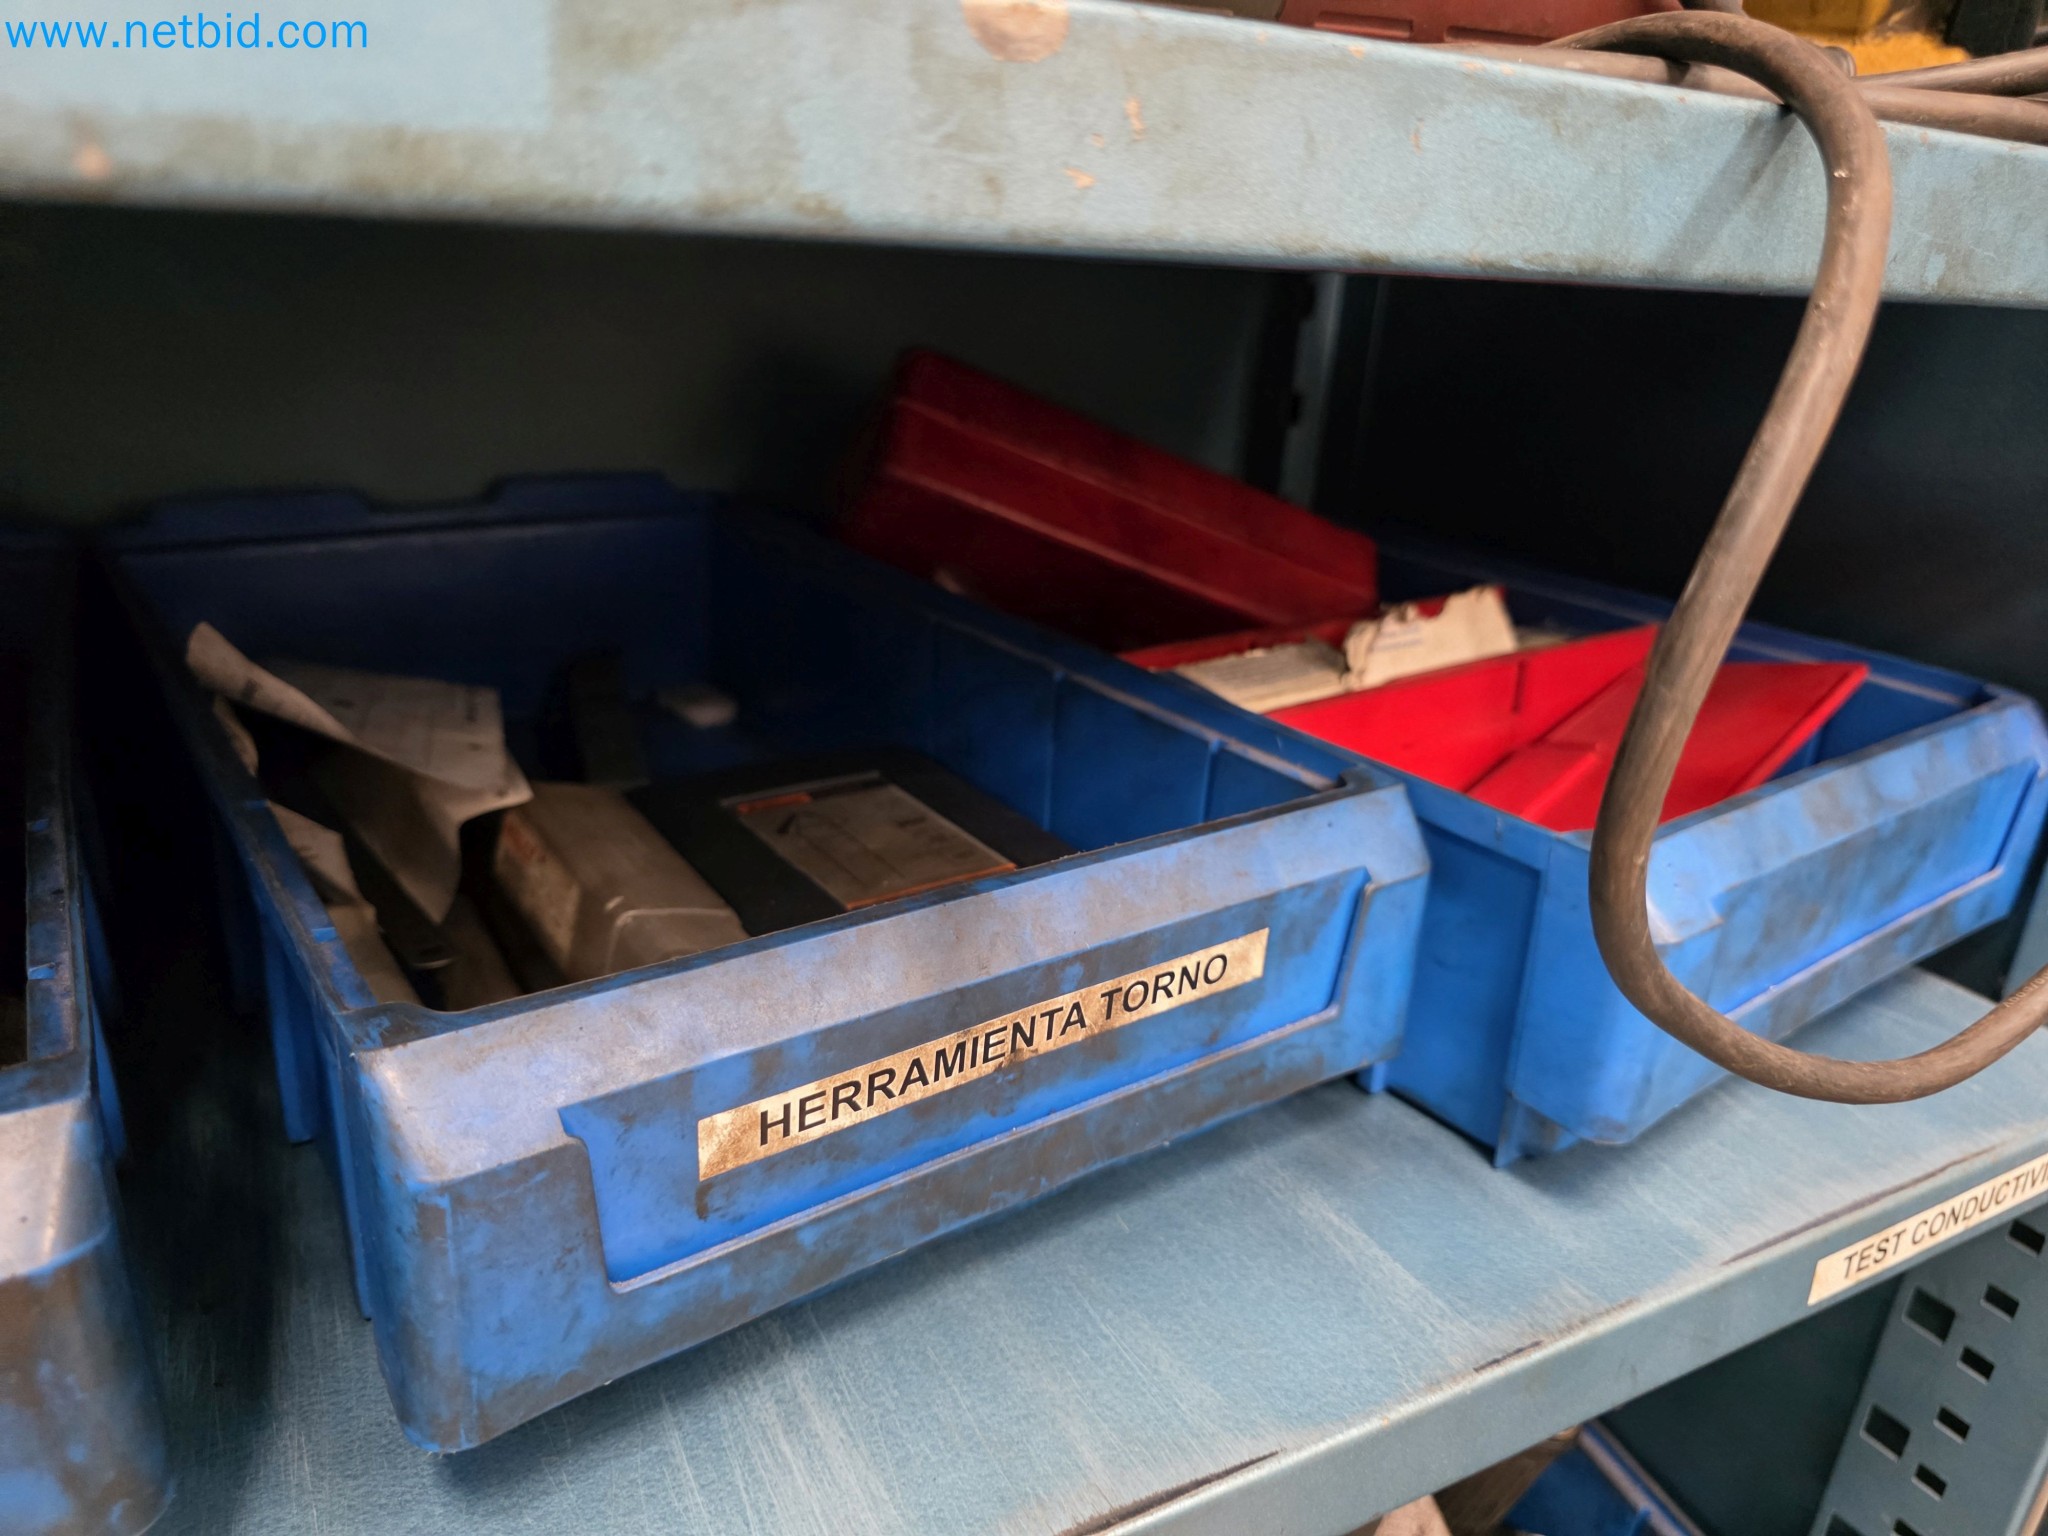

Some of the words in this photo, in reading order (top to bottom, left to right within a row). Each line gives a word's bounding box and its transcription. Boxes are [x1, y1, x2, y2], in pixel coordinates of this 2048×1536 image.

[758, 1000, 1088, 1147] HERRAMIENTA
[1101, 954, 1229, 1021] TORNO
[1844, 1228, 1908, 1279] TEST
[1911, 1162, 2048, 1246] CONDUCTIVI
